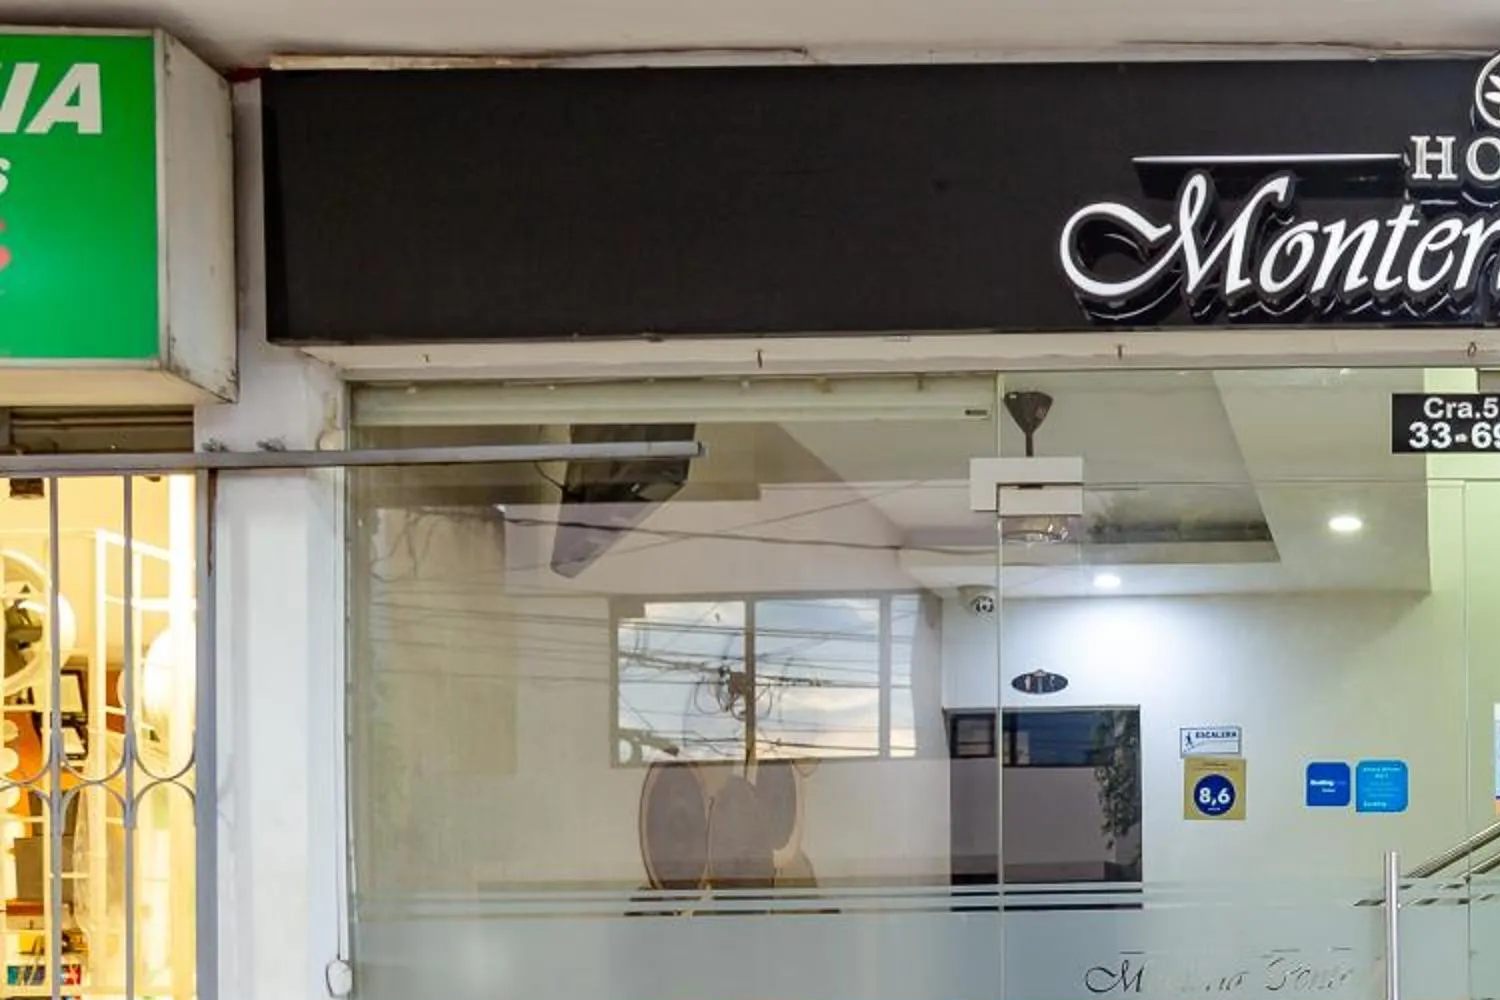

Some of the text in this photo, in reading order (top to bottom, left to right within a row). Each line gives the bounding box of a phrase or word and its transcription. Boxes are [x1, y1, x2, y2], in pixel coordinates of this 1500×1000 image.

[0, 62, 103, 135] IA
[1423, 396, 1500, 420] Cra.5
[1199, 787, 1231, 806] 8,6
